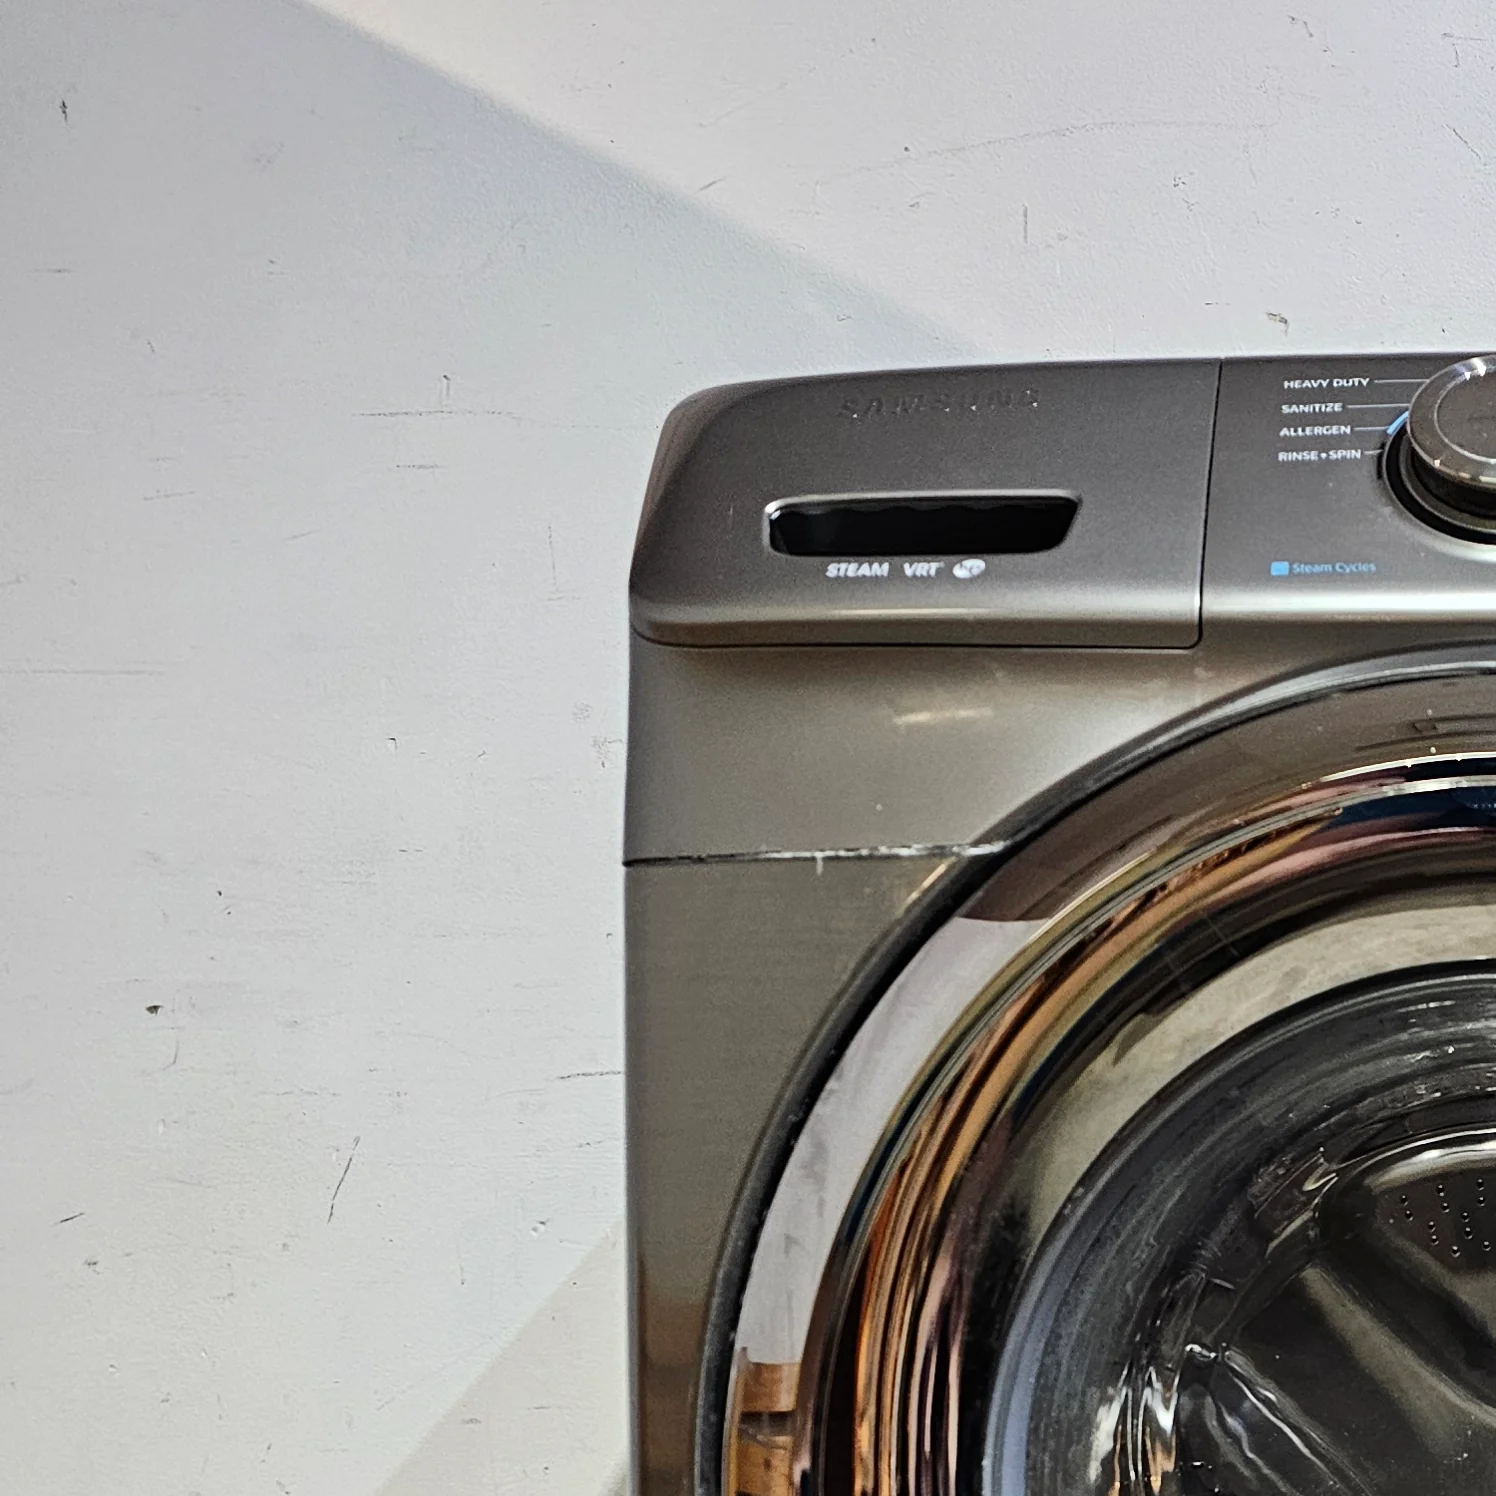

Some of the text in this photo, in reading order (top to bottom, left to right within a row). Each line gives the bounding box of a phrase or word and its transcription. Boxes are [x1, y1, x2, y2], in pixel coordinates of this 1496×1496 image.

[1283, 378, 1370, 389] HEAVY DUTY
[1281, 402, 1343, 414] SANITIZE
[1279, 425, 1351, 437] ALLERGEN
[826, 562, 889, 577] STEAM
[1292, 562, 1376, 574] Steam Cycles
